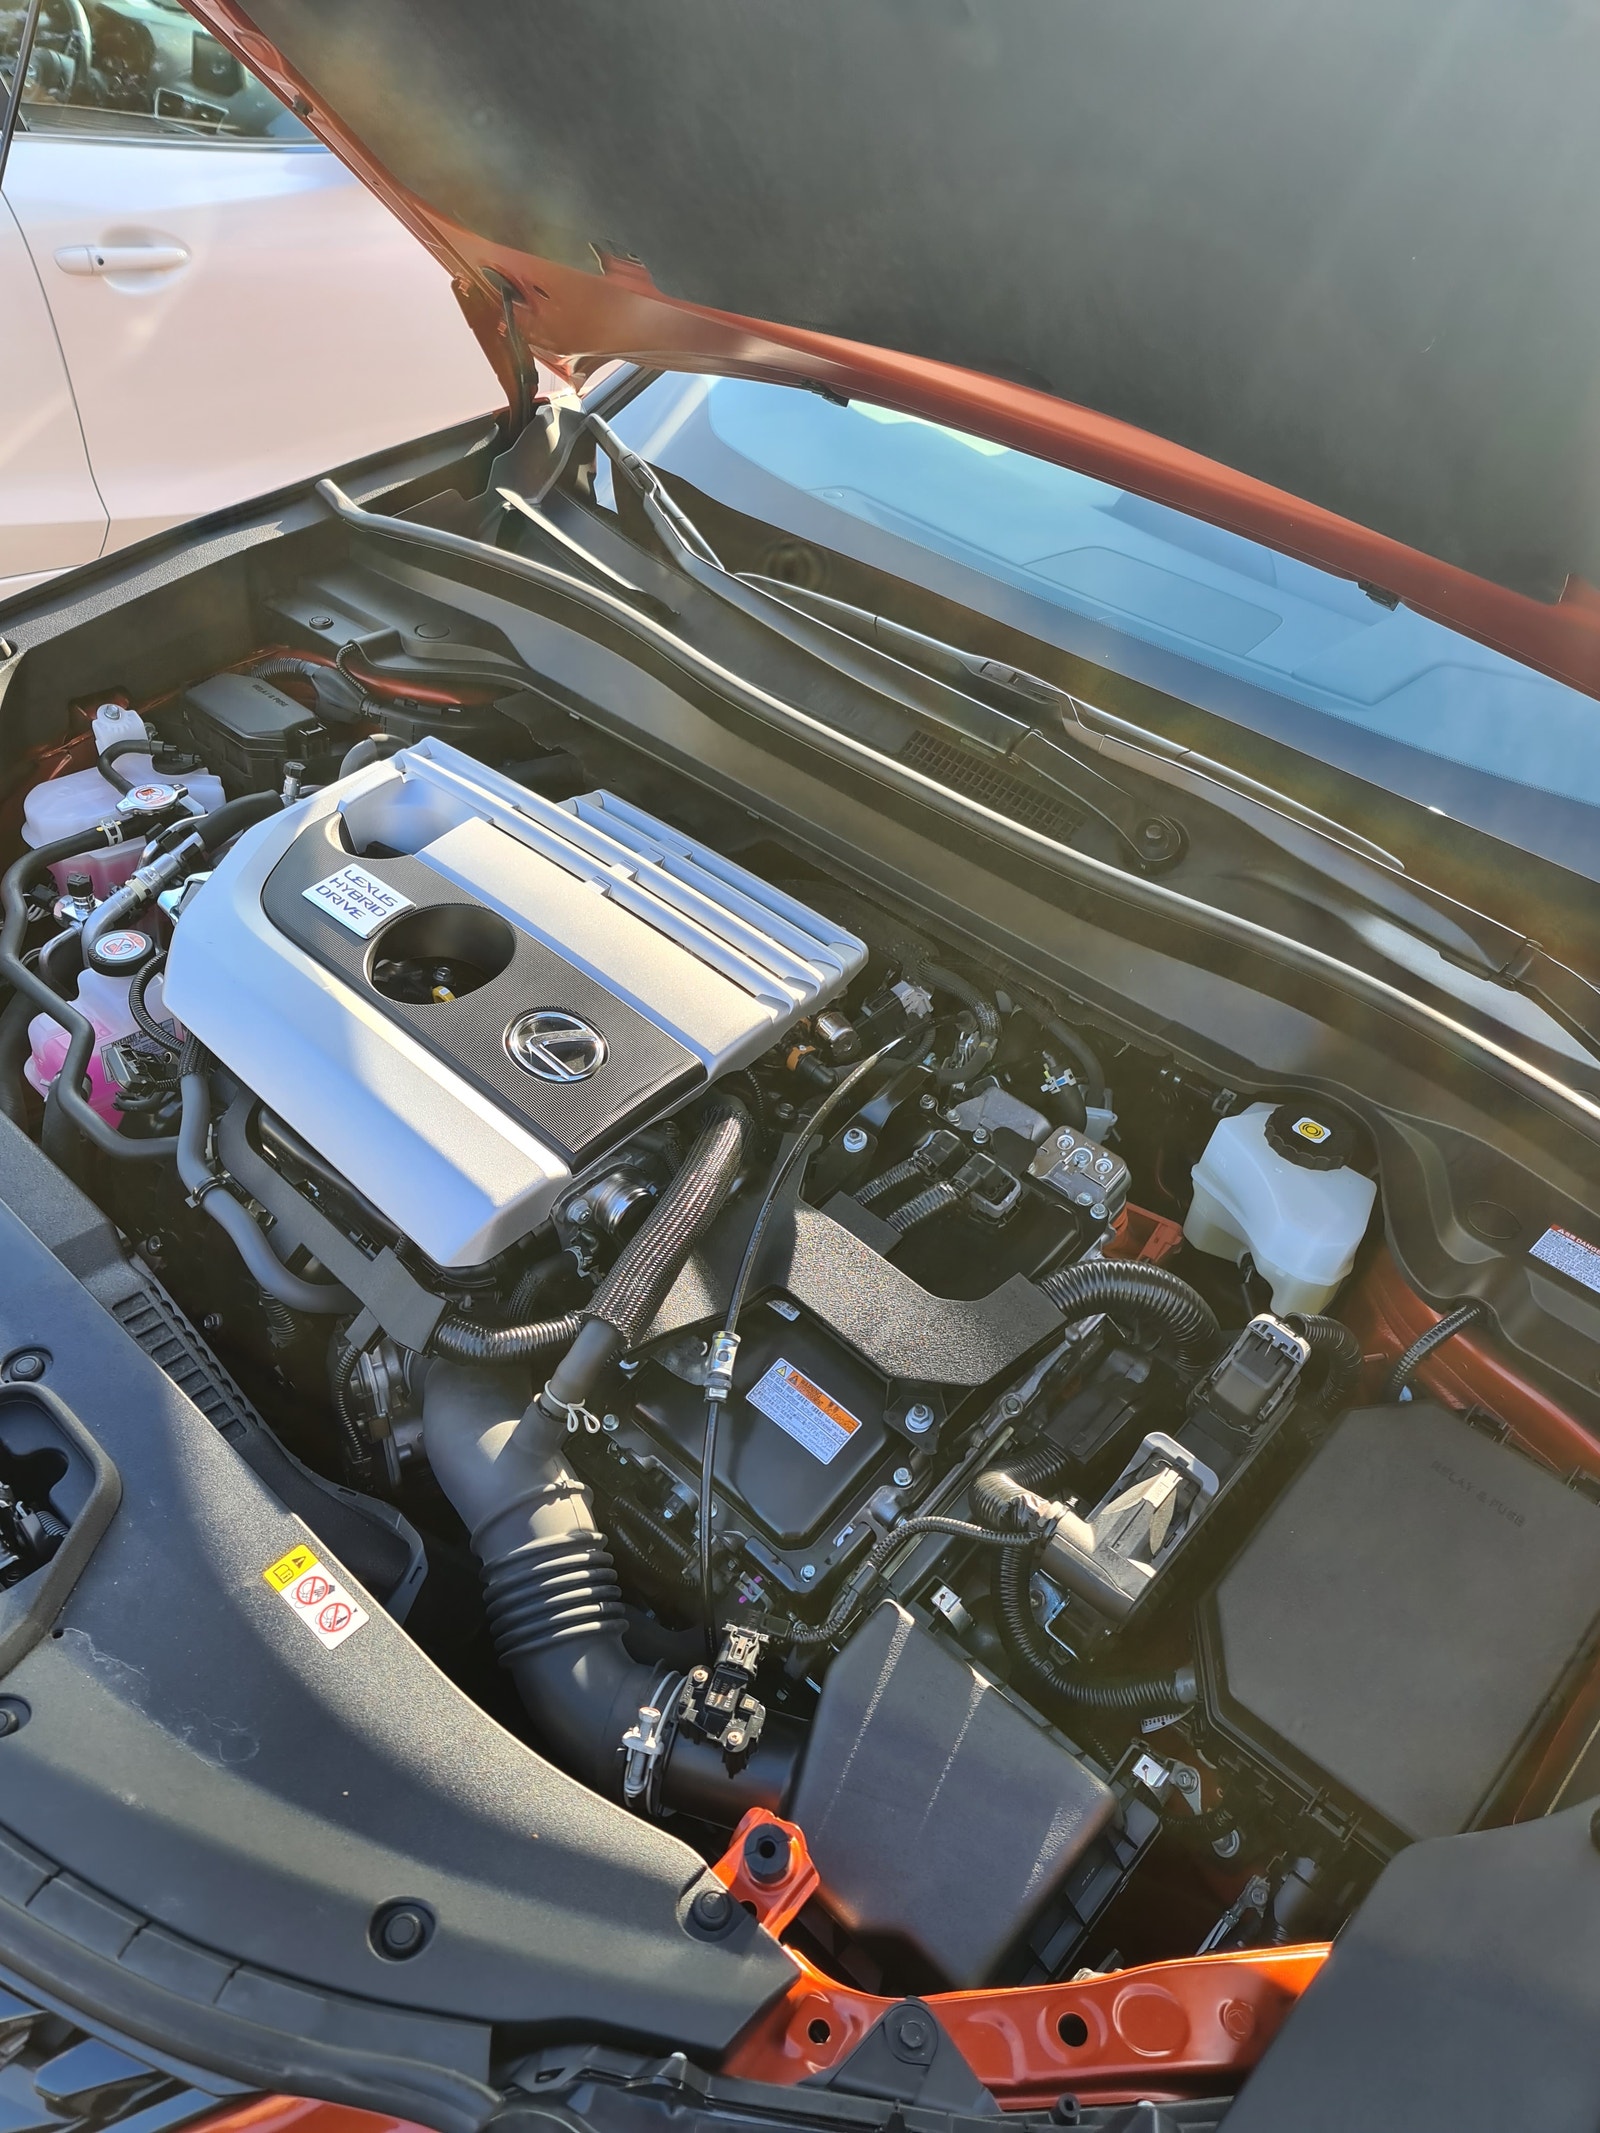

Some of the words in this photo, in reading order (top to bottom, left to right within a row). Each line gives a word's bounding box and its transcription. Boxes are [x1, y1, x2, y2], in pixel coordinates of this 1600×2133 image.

[315, 885, 367, 920] DRIVE
[329, 877, 387, 917] HYBRID
[344, 870, 399, 907] LEXUS
